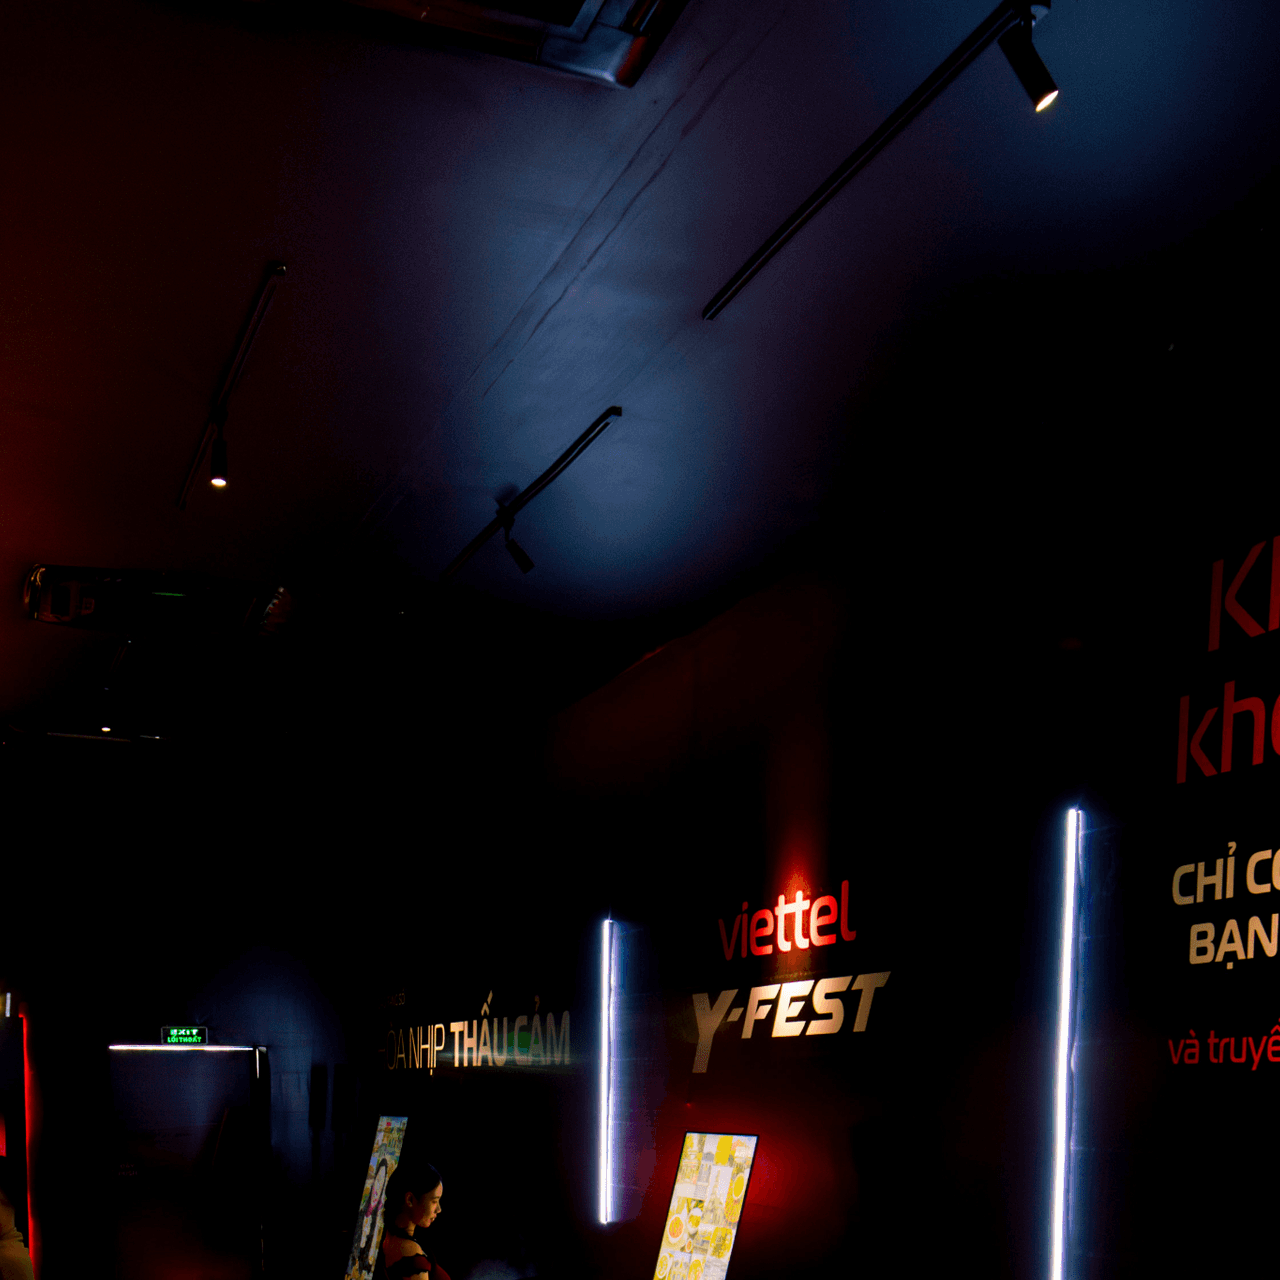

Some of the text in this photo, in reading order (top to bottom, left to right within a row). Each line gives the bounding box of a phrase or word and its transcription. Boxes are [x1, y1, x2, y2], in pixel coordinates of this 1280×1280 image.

[1172, 841, 1237, 906] CHỈ
[718, 880, 858, 961] viettel
[1189, 913, 1280, 970] BẠN
[409, 1023, 446, 1077] NHỊP
[449, 989, 509, 1068] THẤU
[690, 971, 892, 1074] Y-FEST
[1167, 1028, 1200, 1065] và
